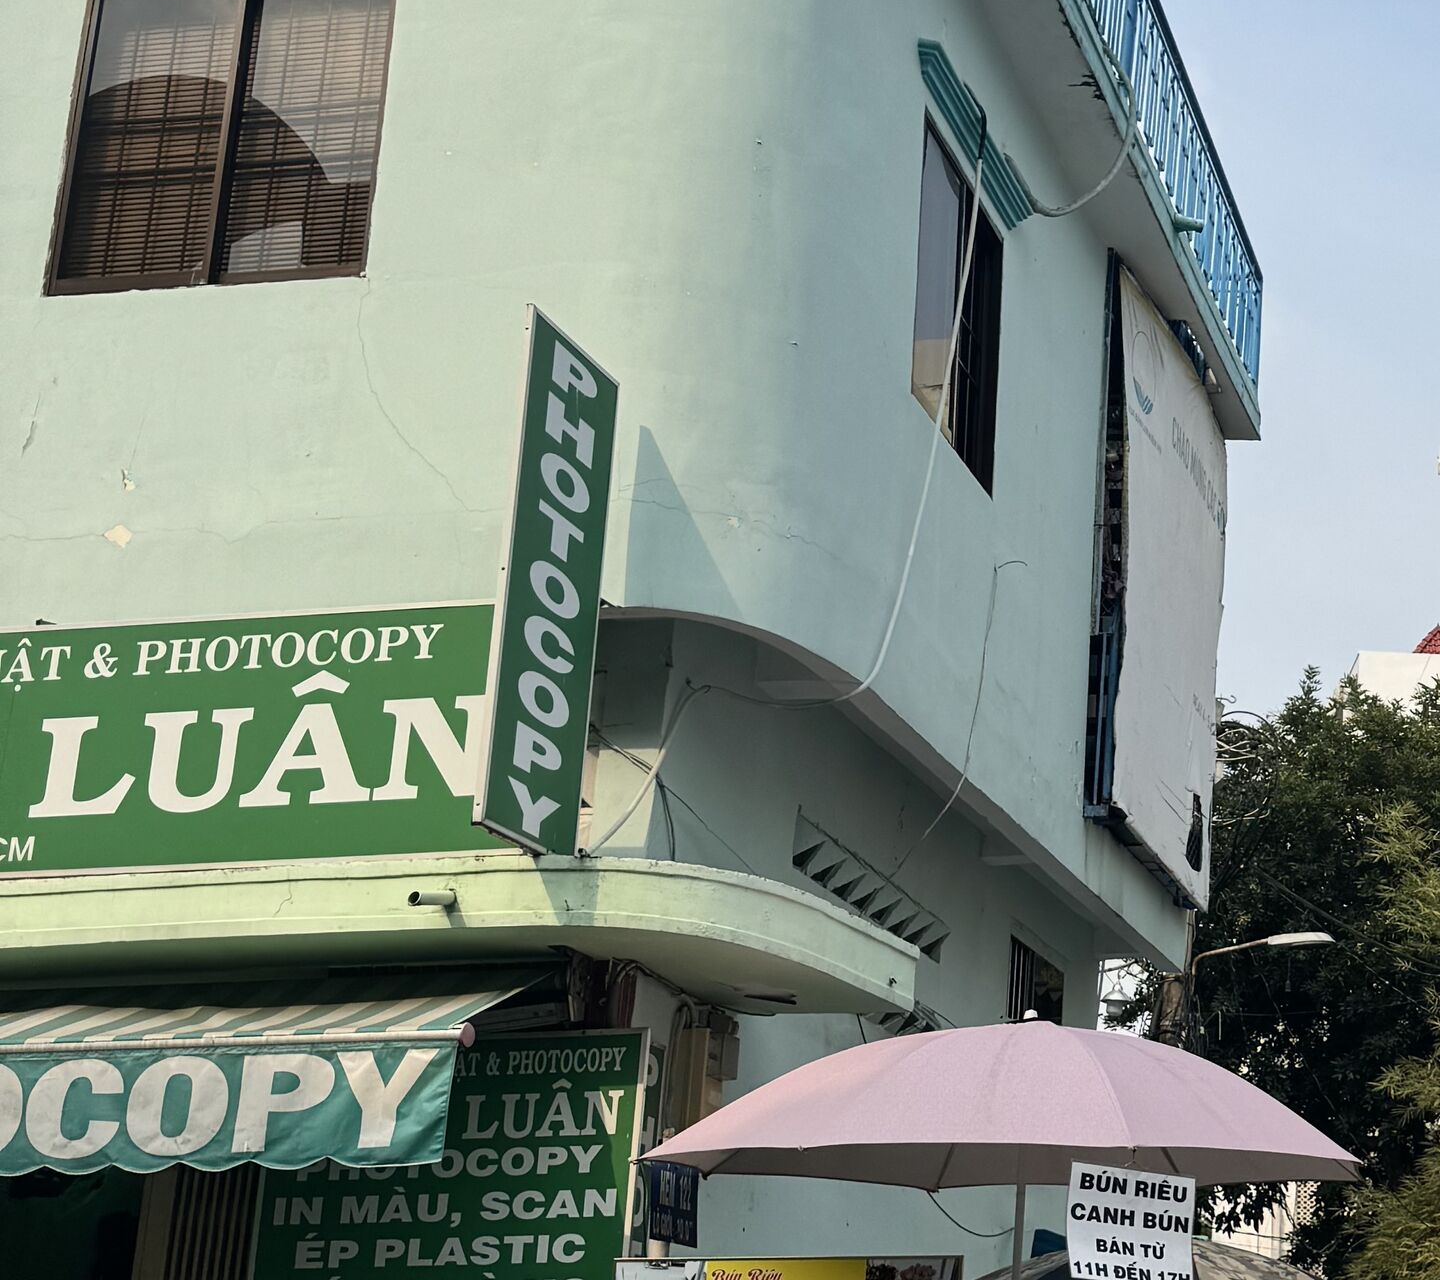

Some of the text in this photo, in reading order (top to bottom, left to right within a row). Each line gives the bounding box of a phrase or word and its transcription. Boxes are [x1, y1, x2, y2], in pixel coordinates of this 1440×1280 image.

[508, 339, 598, 838] PHOTOCOPY
[0, 623, 445, 692] ẬT & PHOTOCOPY
[28, 669, 479, 818] LUÂN
[507, 1047, 627, 1076] PHOTOCOPY
[0, 1048, 440, 1160] COPY
[462, 1078, 625, 1140] LUÂN
[1080, 1170, 1188, 1203] BÚN RIÊU
[272, 1186, 618, 1228] IN MÀU, SCAN
[1070, 1202, 1190, 1234] CANH BÚN
[294, 1232, 587, 1269] ÉP PLASTIC
[1095, 1236, 1165, 1260] BÁN TỪ
[1073, 1261, 1109, 1278] 11H
